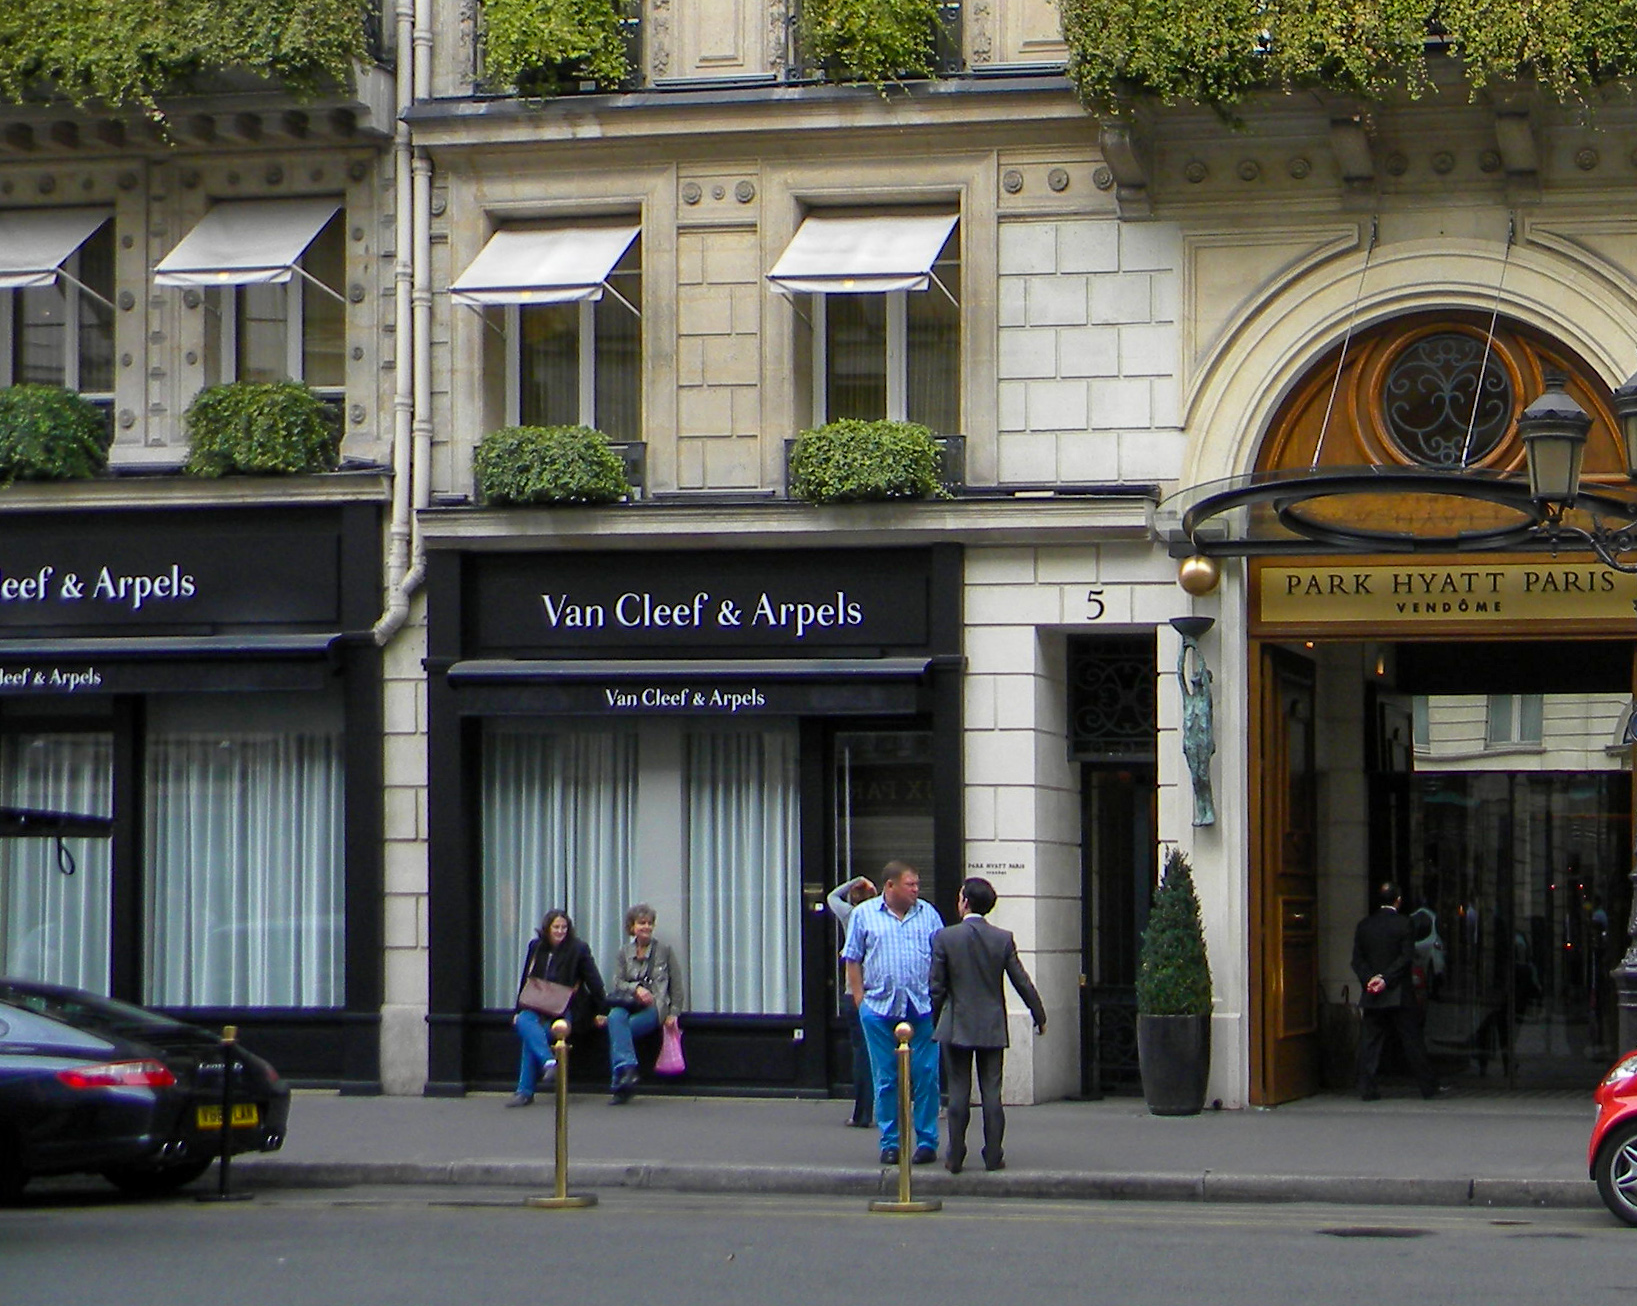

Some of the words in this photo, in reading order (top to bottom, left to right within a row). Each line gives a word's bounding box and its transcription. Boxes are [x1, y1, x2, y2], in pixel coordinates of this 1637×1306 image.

[0, 565, 54, 600] eef
[61, 573, 84, 598] &
[93, 564, 197, 608] Arpels
[1286, 573, 1374, 595] PARK
[1393, 571, 1505, 594] HYATT
[1524, 570, 1616, 593] PARIS
[541, 593, 605, 627] Van
[614, 592, 709, 627] Cleef
[717, 598, 742, 626] &
[751, 591, 863, 637] Arpels
[1086, 589, 1105, 620] 5
[1397, 598, 1502, 613] VENDÔME
[33, 670, 46, 685] &
[49, 667, 102, 692] Arpels
[605, 689, 637, 707] Van
[641, 688, 689, 707] Cleef
[692, 692, 706, 707] &
[709, 688, 766, 712] Arpels
